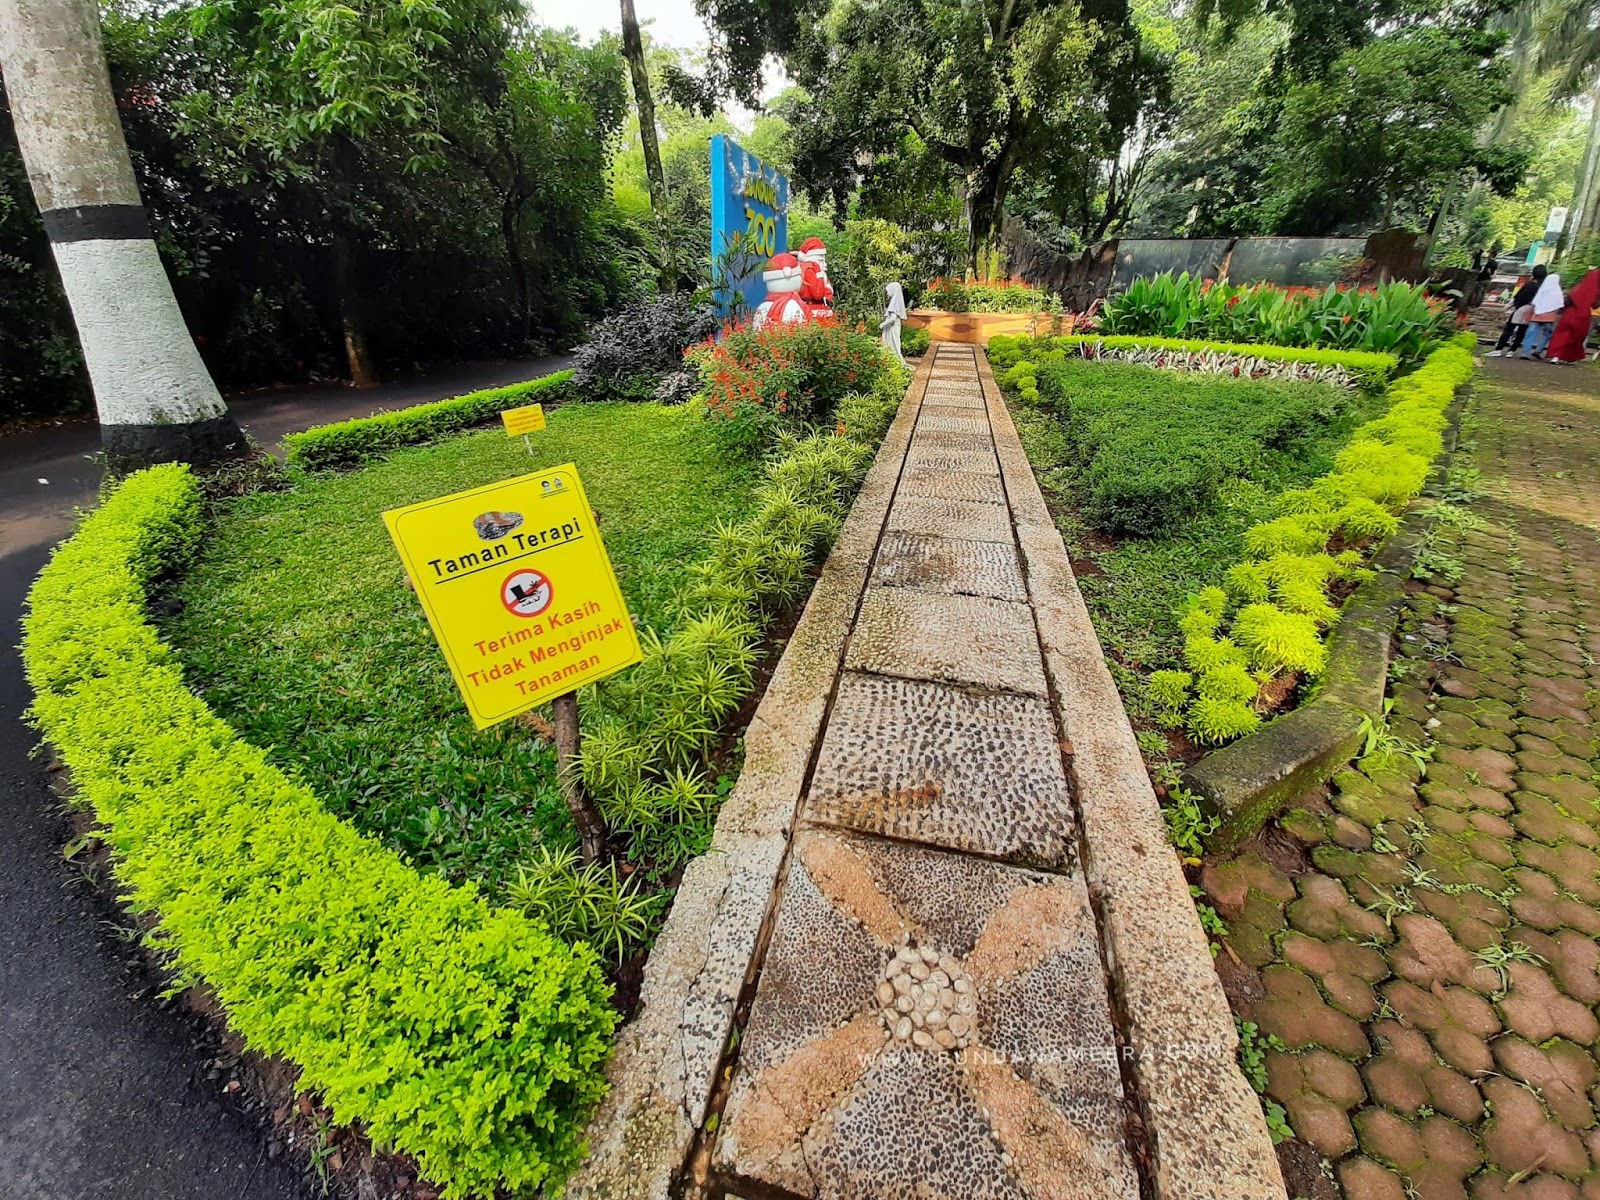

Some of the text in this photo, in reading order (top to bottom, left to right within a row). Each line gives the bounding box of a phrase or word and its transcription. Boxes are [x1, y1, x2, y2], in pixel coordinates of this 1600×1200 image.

[428, 517, 581, 577] Taman Terapi
[467, 617, 624, 687] Tidak Menginjak
[474, 600, 602, 657] Terima Kasih
[514, 653, 601, 696] Tanaman
